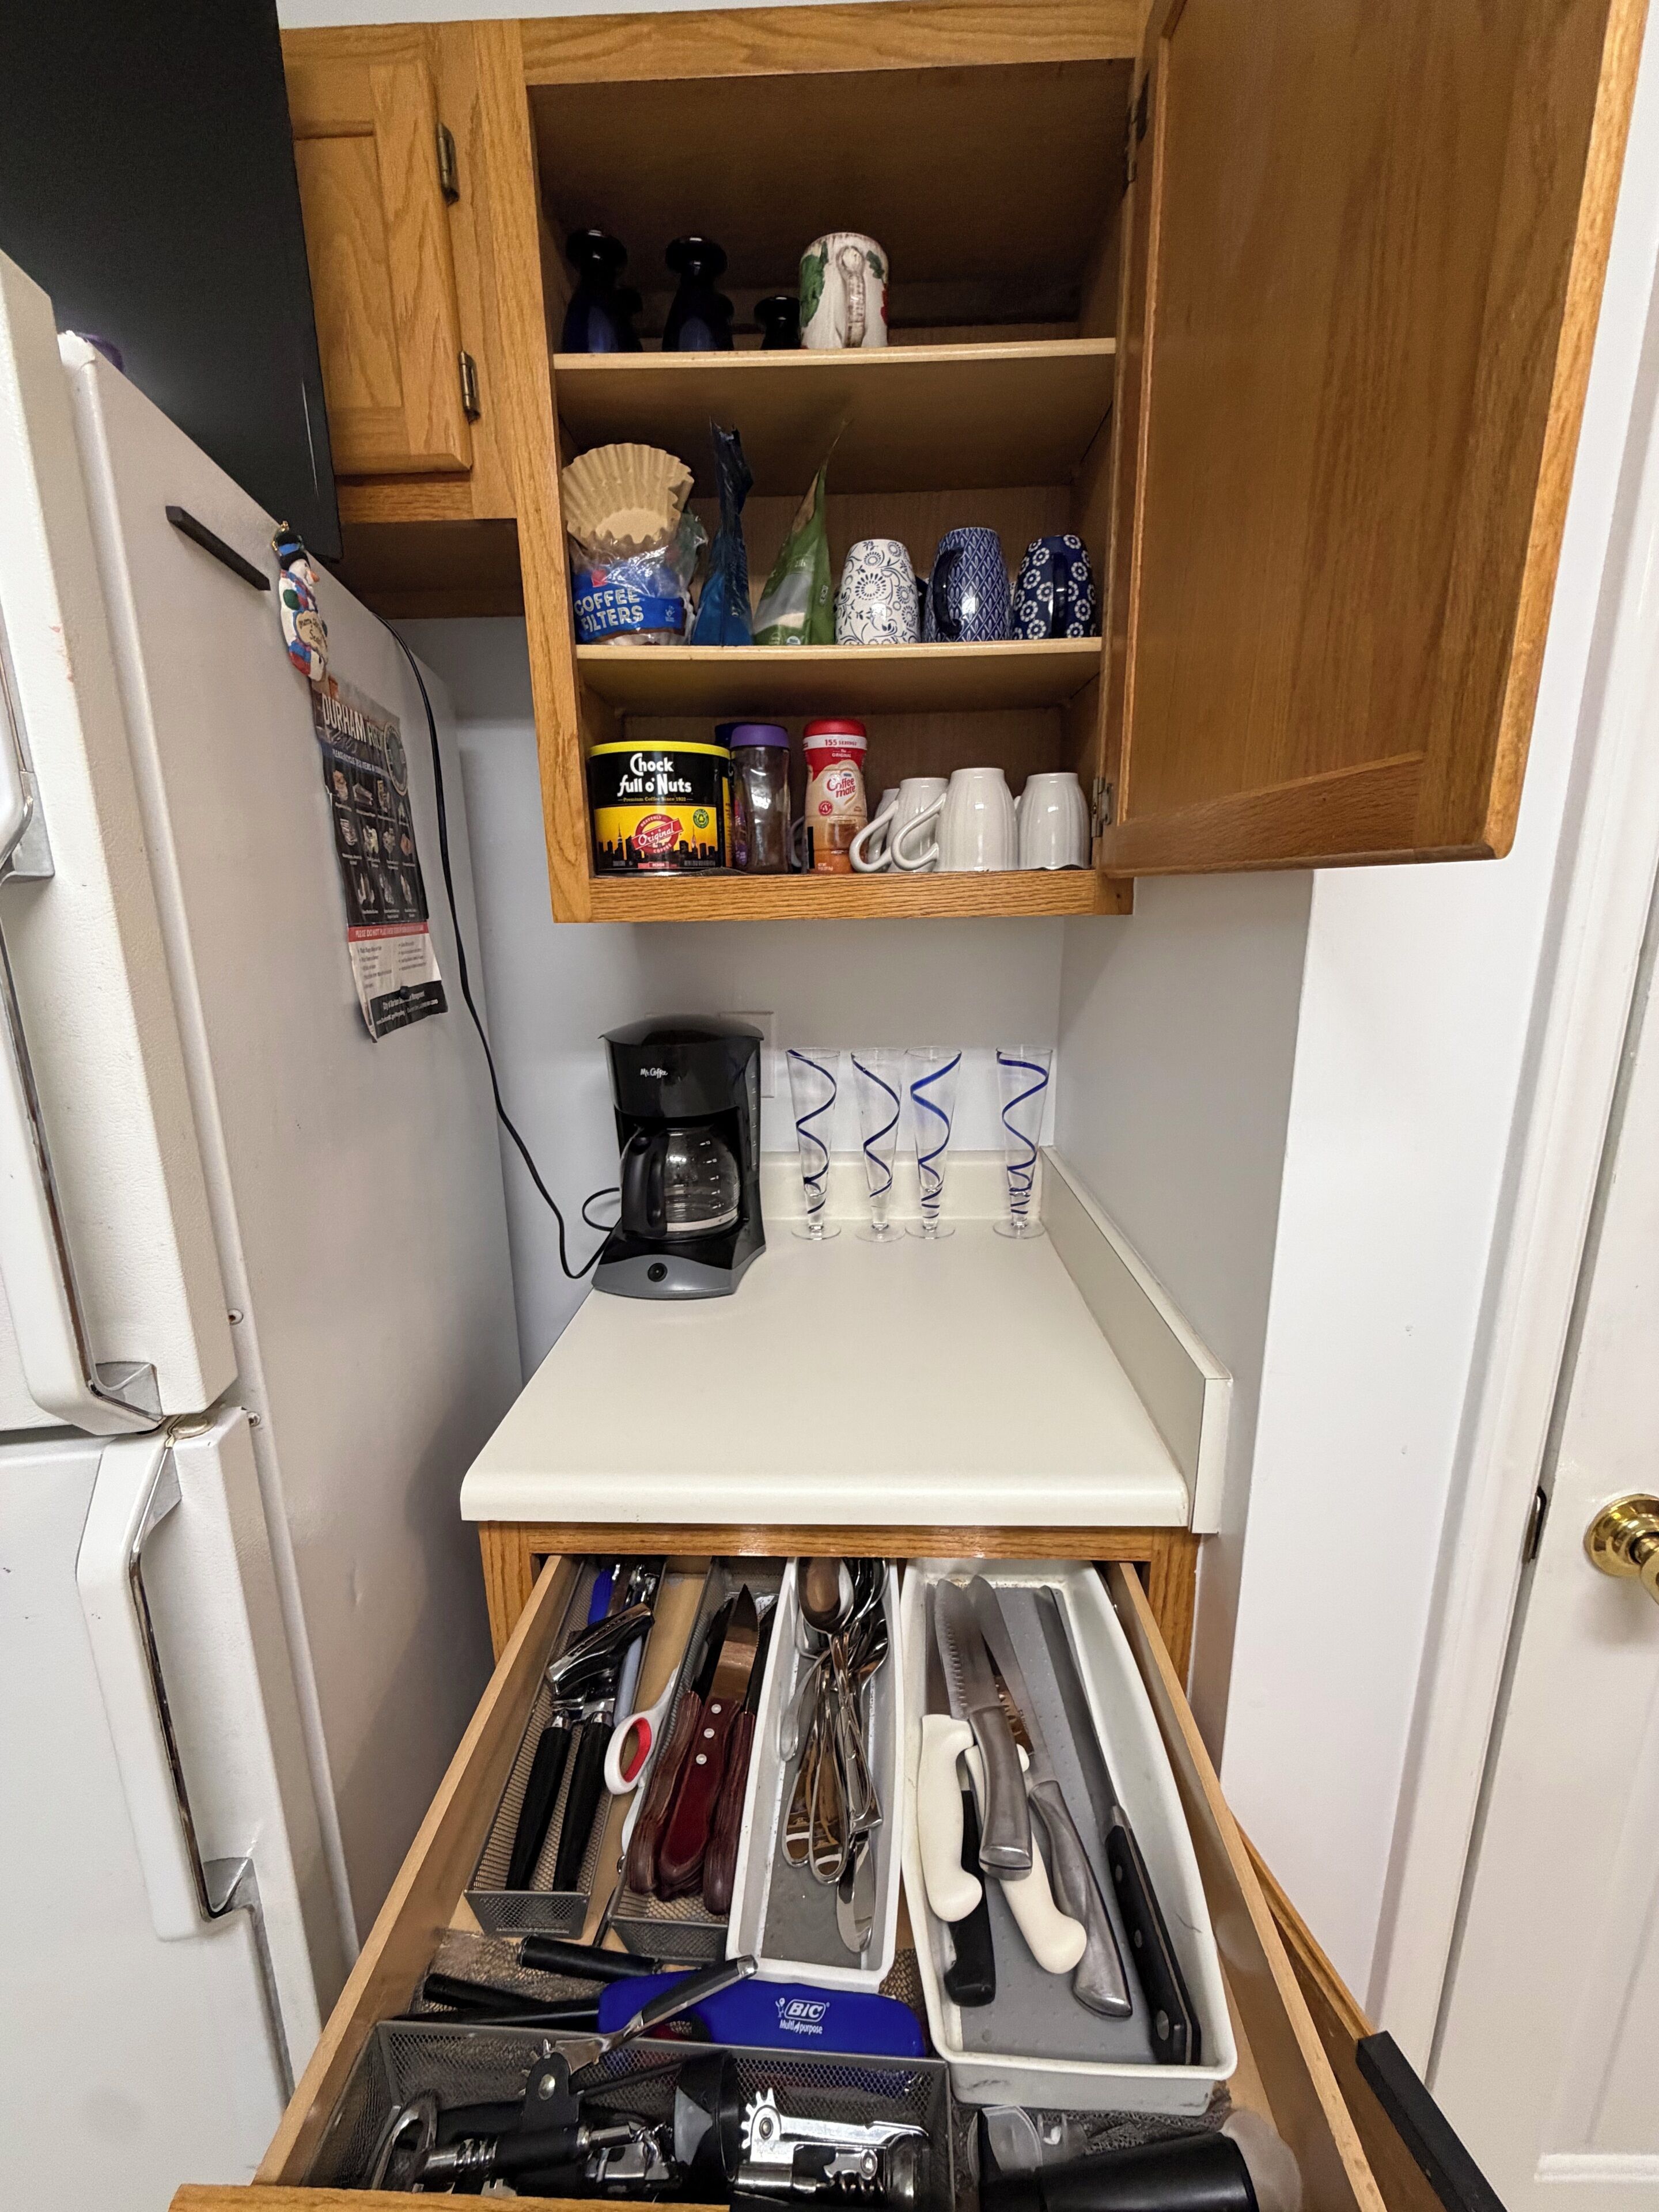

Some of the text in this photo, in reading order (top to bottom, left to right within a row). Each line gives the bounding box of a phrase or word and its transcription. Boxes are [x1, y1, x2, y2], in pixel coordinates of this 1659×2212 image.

[574, 586, 641, 616] COFFEE
[581, 605, 644, 632] FILTERS
[322, 693, 367, 743] DURHAM
[630, 752, 674, 777] Chock
[617, 774, 643, 797] full
[657, 773, 692, 795] Nuts
[835, 785, 856, 798] mate
[640, 815, 662, 827] HEAVENLY
[638, 822, 674, 846] Original
[653, 843, 672, 854] COFFEE
[787, 2002, 824, 2018] BIC
[799, 2023, 823, 2036] purpose
